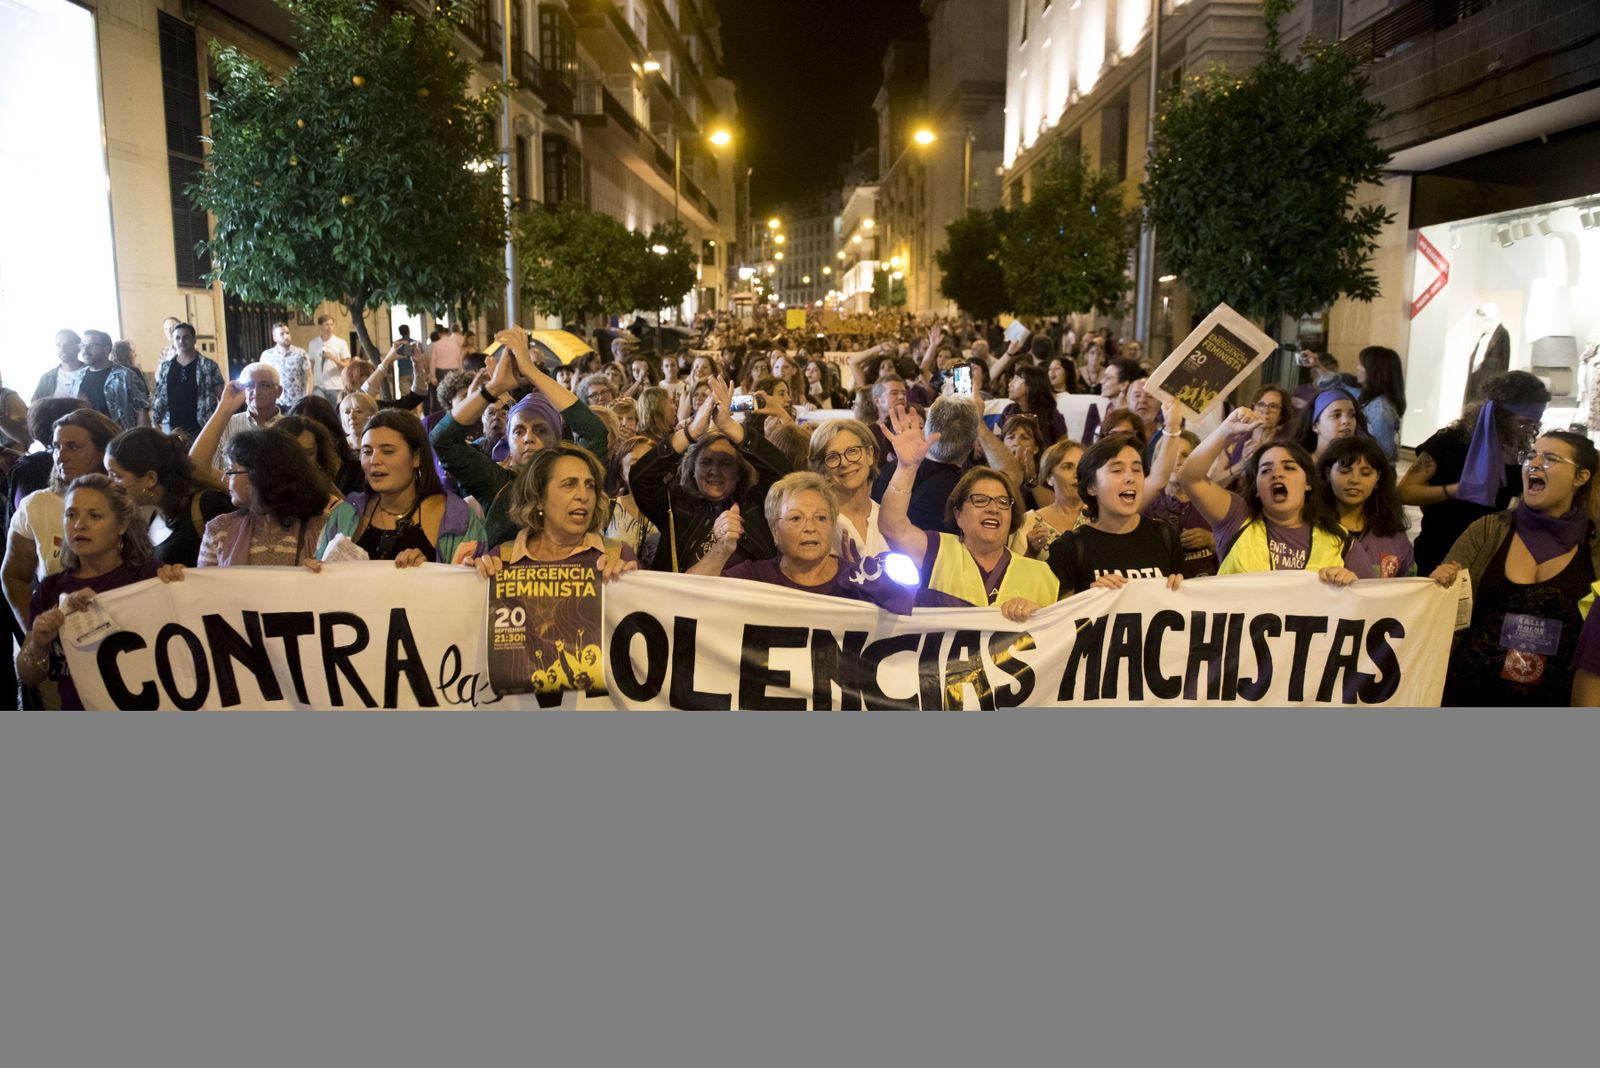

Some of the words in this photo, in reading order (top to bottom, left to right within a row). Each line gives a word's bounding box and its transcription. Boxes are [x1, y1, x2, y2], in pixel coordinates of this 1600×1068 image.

[1190, 350, 1207, 364] 20
[1202, 340, 1241, 371] FEMINISTA
[1208, 333, 1248, 364] EMERGENCIA
[495, 567, 596, 582] EMERGENCIA
[495, 582, 596, 598] FEMINISTA
[494, 606, 526, 628] 20
[494, 632, 526, 643] 21:30h
[96, 608, 441, 711] CONTRA
[1057, 608, 1405, 704] MACHISTAS
